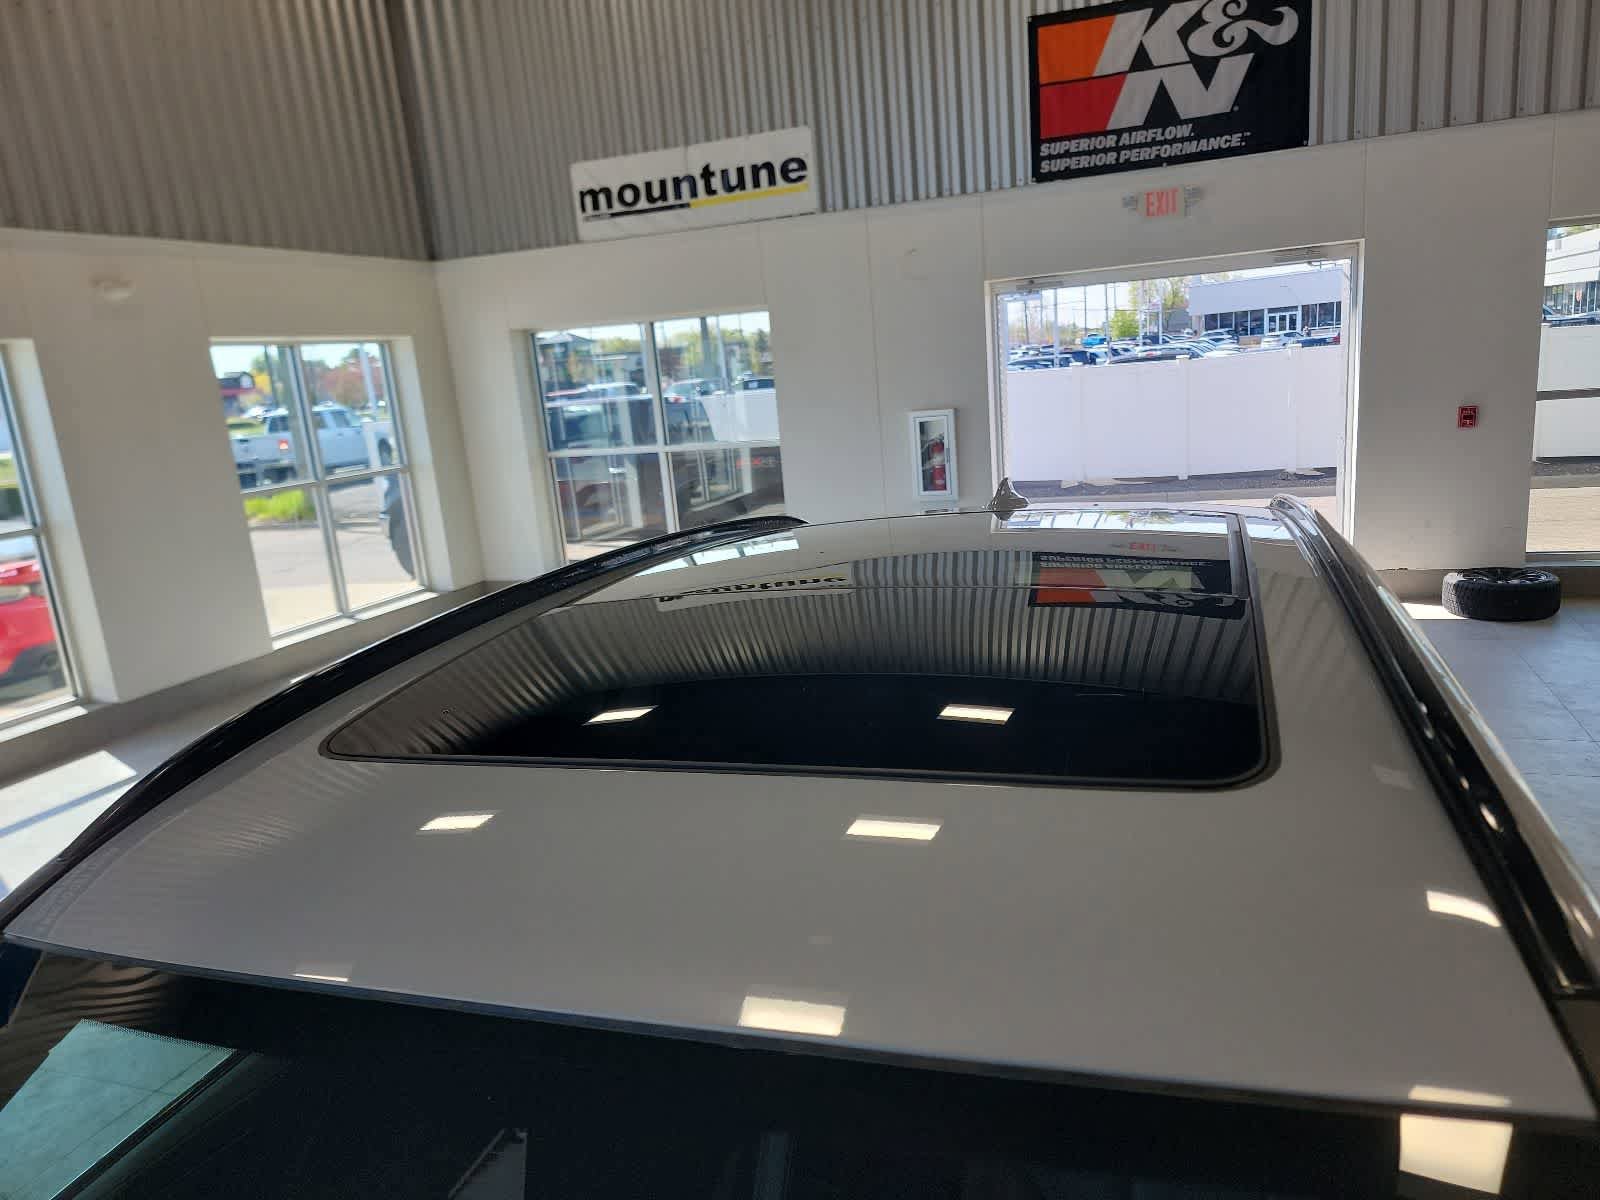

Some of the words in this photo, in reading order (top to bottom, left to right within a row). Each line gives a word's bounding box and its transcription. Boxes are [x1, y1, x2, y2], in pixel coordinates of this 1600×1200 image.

[1040, 134, 1118, 156] SUPERIOR
[1119, 123, 1194, 146] AIRFLOW.
[1040, 152, 1118, 173] SUPERIOR
[579, 157, 807, 213] mountune
[1145, 187, 1179, 217] EXIT
